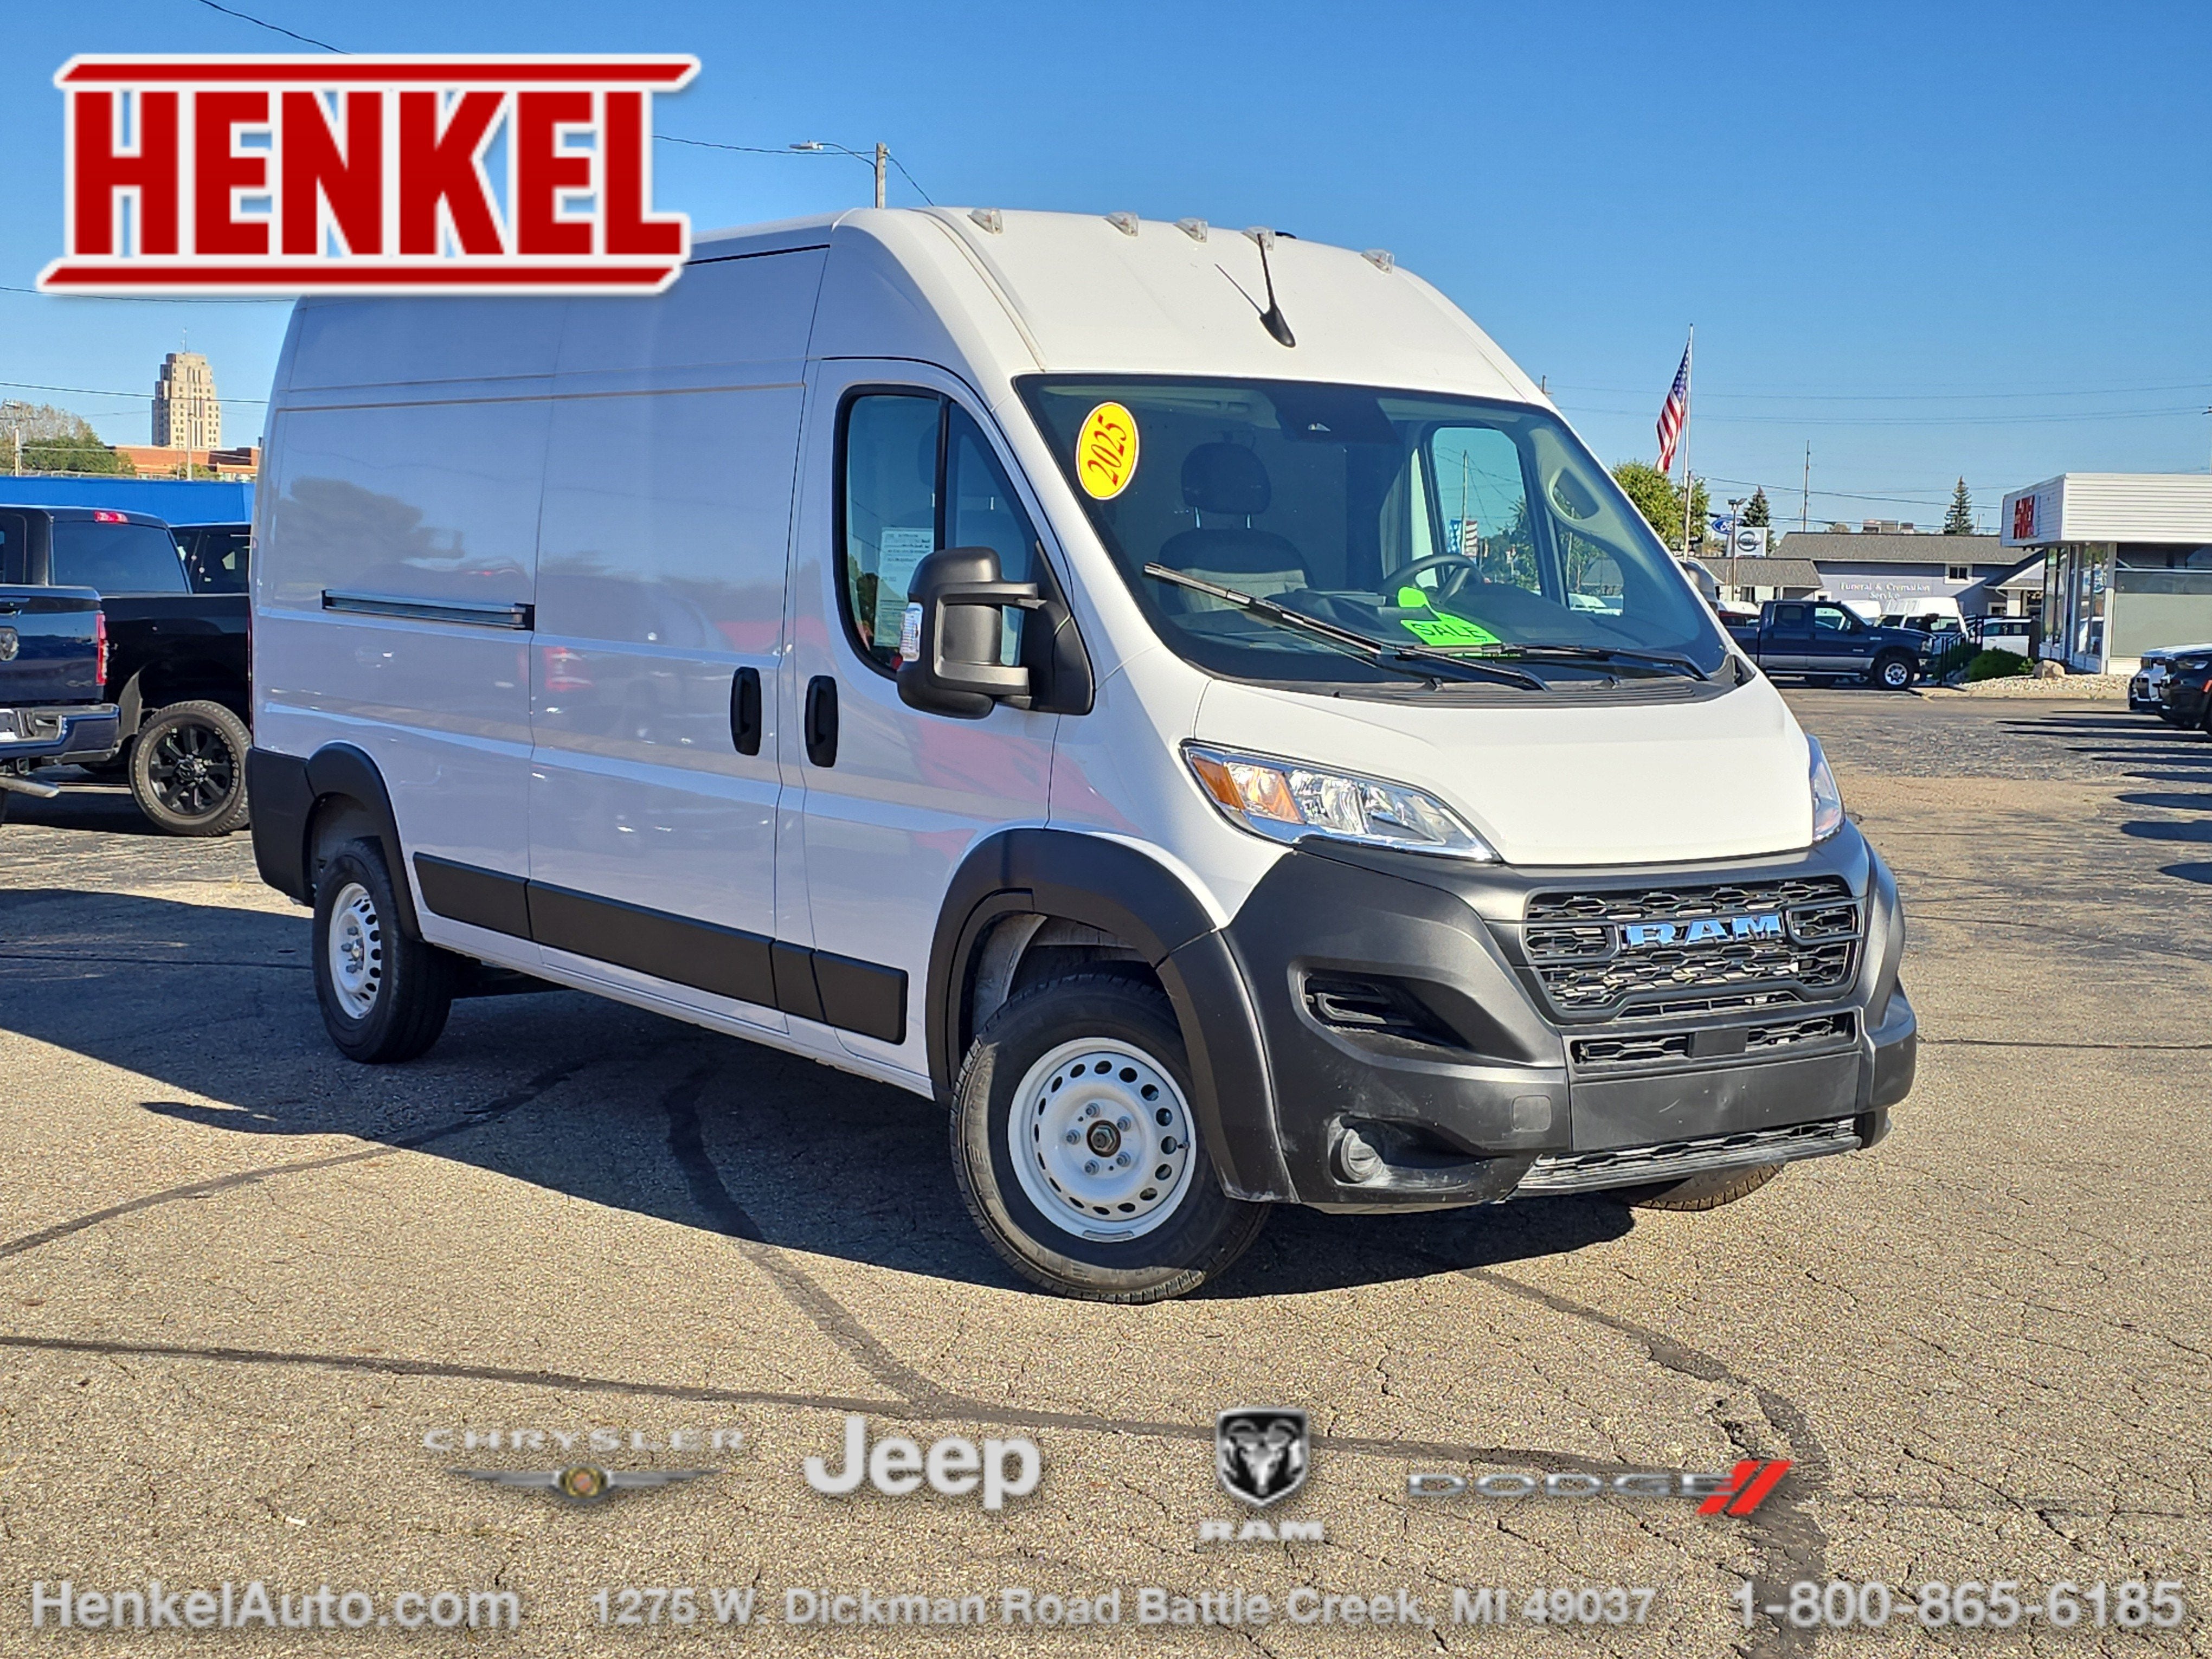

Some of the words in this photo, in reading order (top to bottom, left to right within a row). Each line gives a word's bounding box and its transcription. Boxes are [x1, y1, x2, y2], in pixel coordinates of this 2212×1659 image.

[1087, 413, 1127, 486] 2025
[1841, 582, 1872, 590] Funeral
[1411, 623, 1487, 640] SALE
[1626, 914, 1783, 948] RAM
